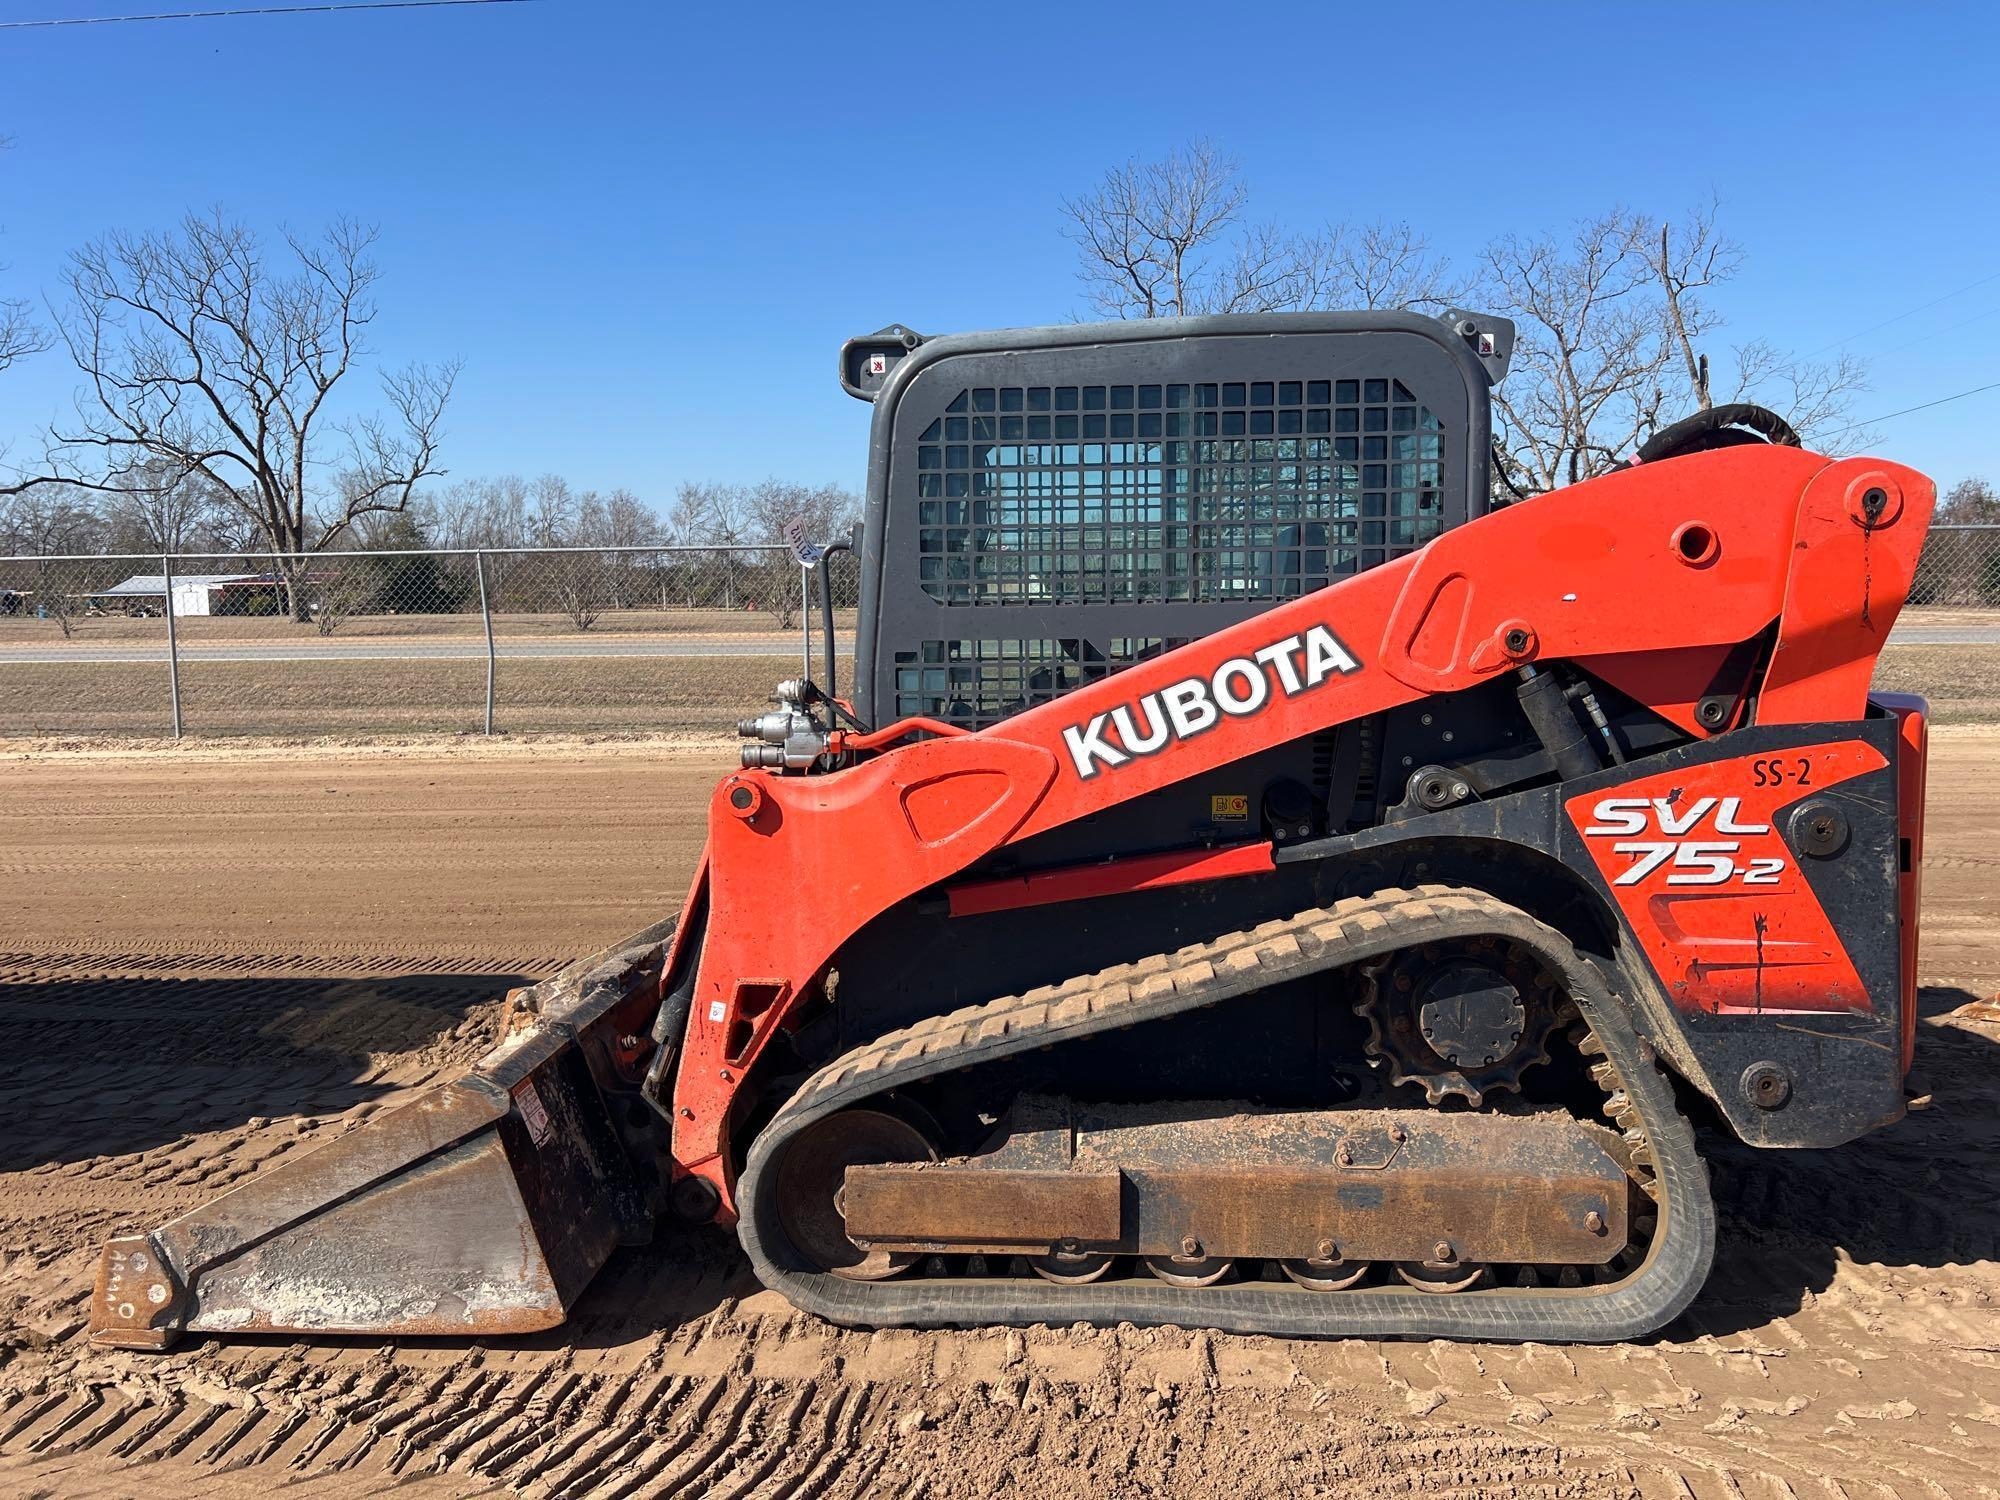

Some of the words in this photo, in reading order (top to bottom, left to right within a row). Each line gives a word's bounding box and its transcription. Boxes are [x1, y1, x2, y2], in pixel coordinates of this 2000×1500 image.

[1062, 625, 1361, 779] KUBOTA
[1753, 758, 1811, 787] SS-2
[1584, 797, 1771, 836] SVL
[1612, 841, 1786, 886] 75-2
